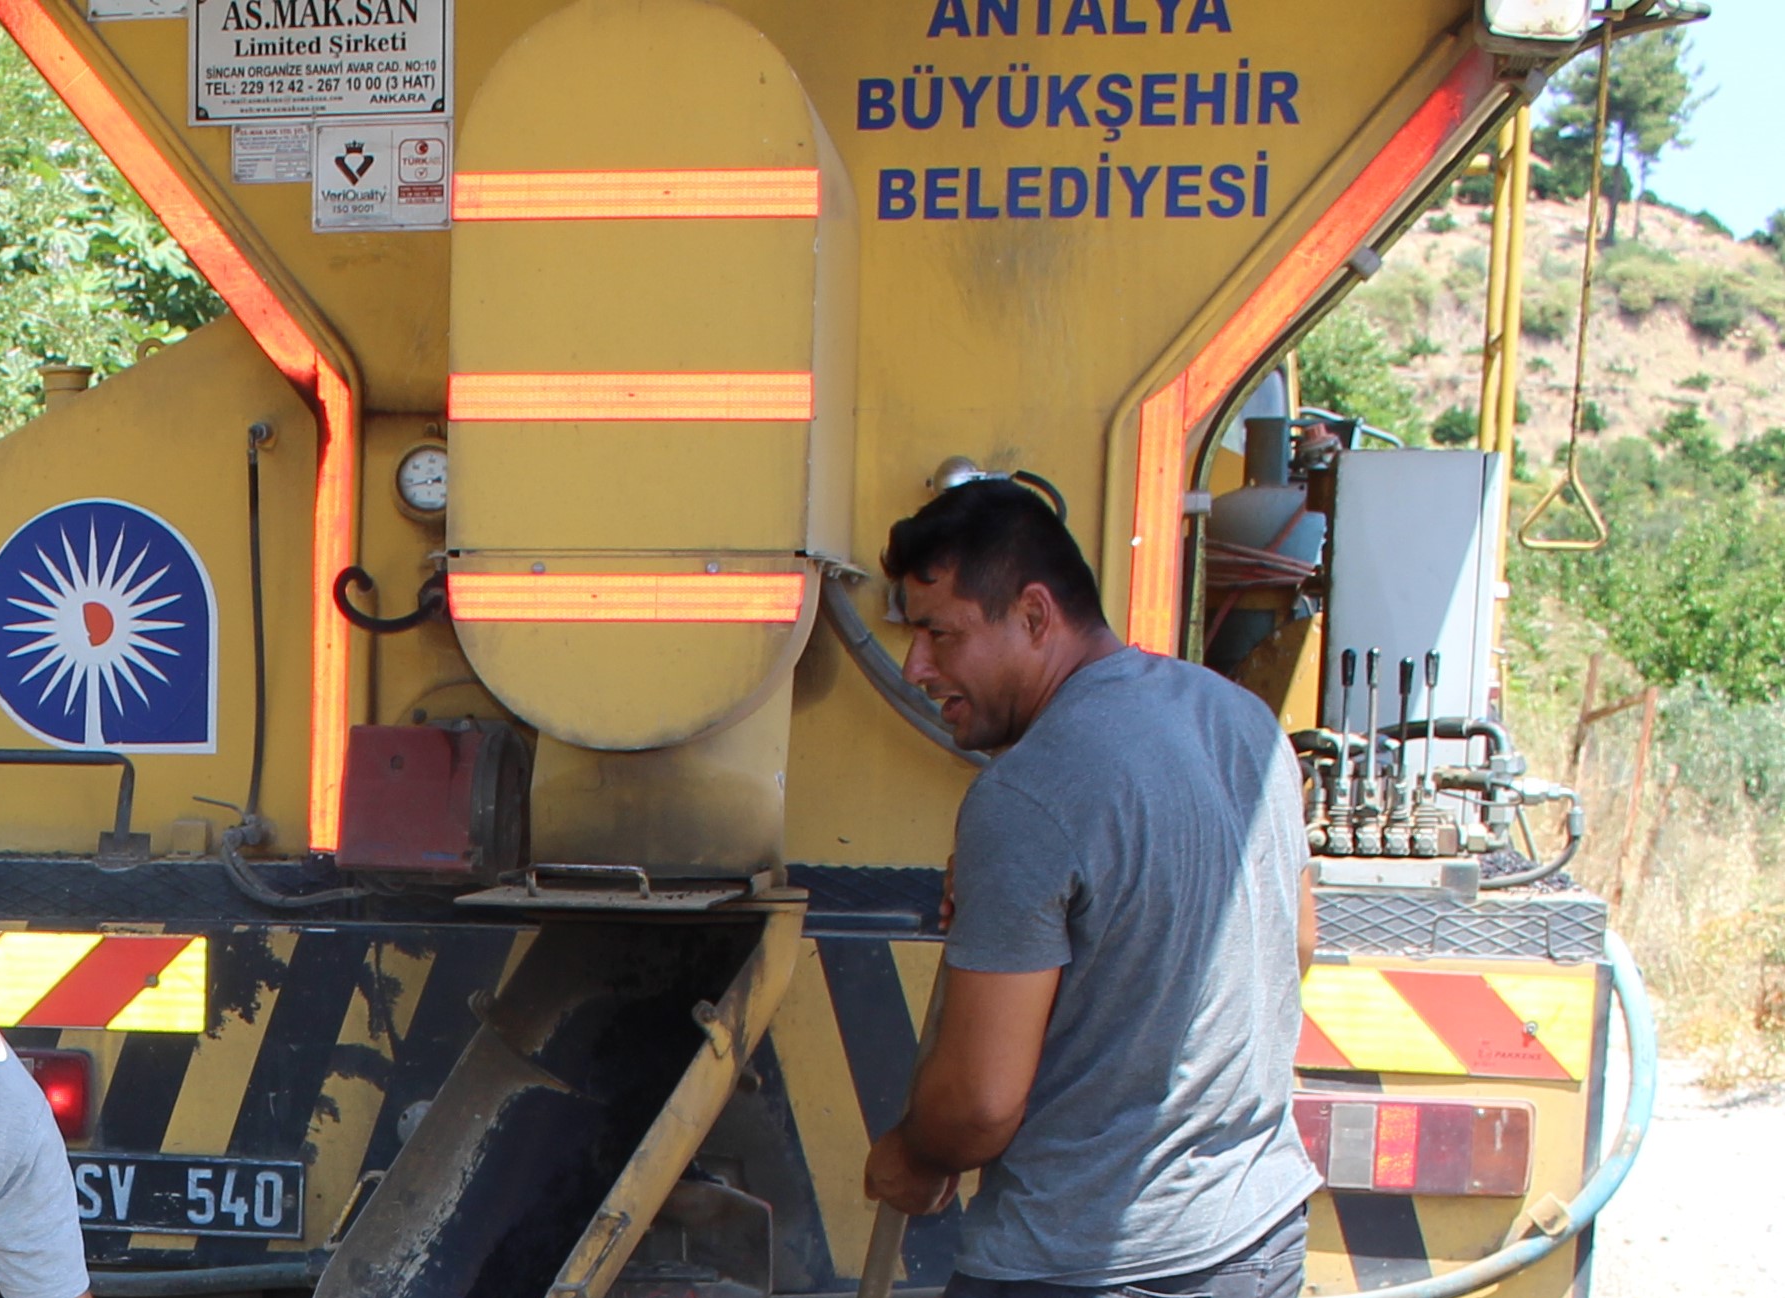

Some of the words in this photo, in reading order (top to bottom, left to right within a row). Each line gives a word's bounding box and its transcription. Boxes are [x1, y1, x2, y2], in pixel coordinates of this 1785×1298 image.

[221, 0, 419, 31] AS.MAK.SAN
[234, 35, 322, 57] Limited
[329, 31, 406, 58] Şirketi
[205, 65, 245, 79] SİNCAN
[247, 62, 302, 78] ORGANİZE
[305, 60, 343, 75] SANAYİ
[346, 62, 374, 74] AVAR
[205, 81, 236, 96] TEL:
[240, 80, 265, 95] 229
[269, 80, 284, 94] 12
[287, 79, 304, 93] 42
[317, 77, 341, 92] 267
[346, 77, 362, 91] 10
[365, 76, 382, 90] 00
[386, 75, 399, 92] (3
[402, 74, 436, 91] HAT)
[369, 92, 427, 104] ANKARA
[856, 58, 1301, 142] BÜYÜKŞEHİR
[321, 188, 386, 203] VeriQuality
[877, 150, 1270, 220] BELEDİYESİ
[352, 203, 374, 213] 9001
[186, 1168, 284, 1228] 540
